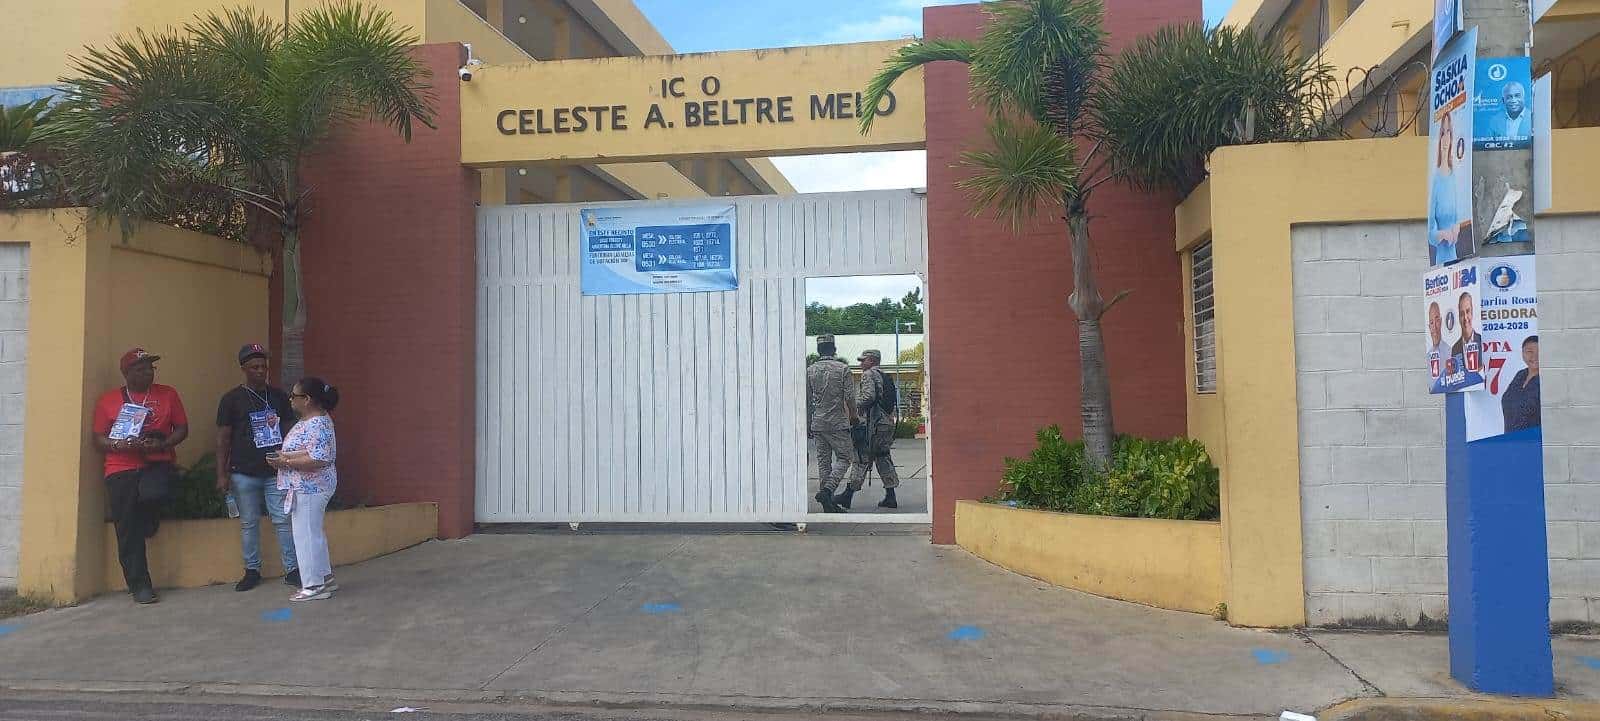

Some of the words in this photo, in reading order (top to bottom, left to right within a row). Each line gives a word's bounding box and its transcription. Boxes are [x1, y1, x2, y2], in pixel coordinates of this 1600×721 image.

[1435, 54, 1467, 92] SASKIA
[1434, 75, 1465, 110] OCHOA
[496, 106, 627, 135] CELESTE
[643, 103, 674, 129] A.
[685, 97, 794, 128] BELTRE
[1483, 321, 1529, 331] 2024-2028
